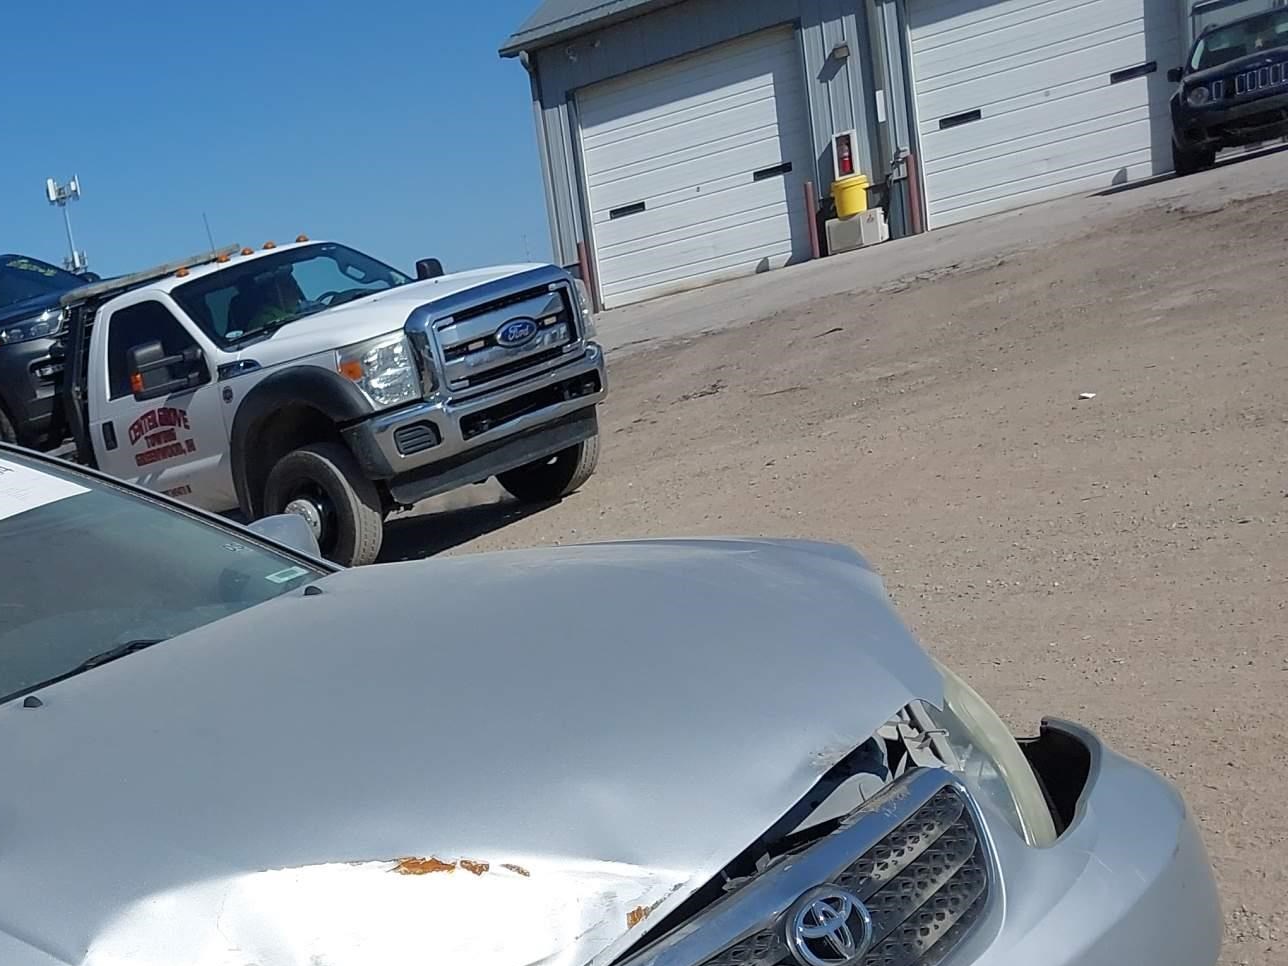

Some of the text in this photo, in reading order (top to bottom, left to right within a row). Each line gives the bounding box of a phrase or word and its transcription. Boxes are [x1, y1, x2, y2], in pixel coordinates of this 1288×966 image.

[507, 323, 530, 341] Ford
[128, 407, 191, 446] CENTER GROVE
[144, 428, 178, 449] TOWING
